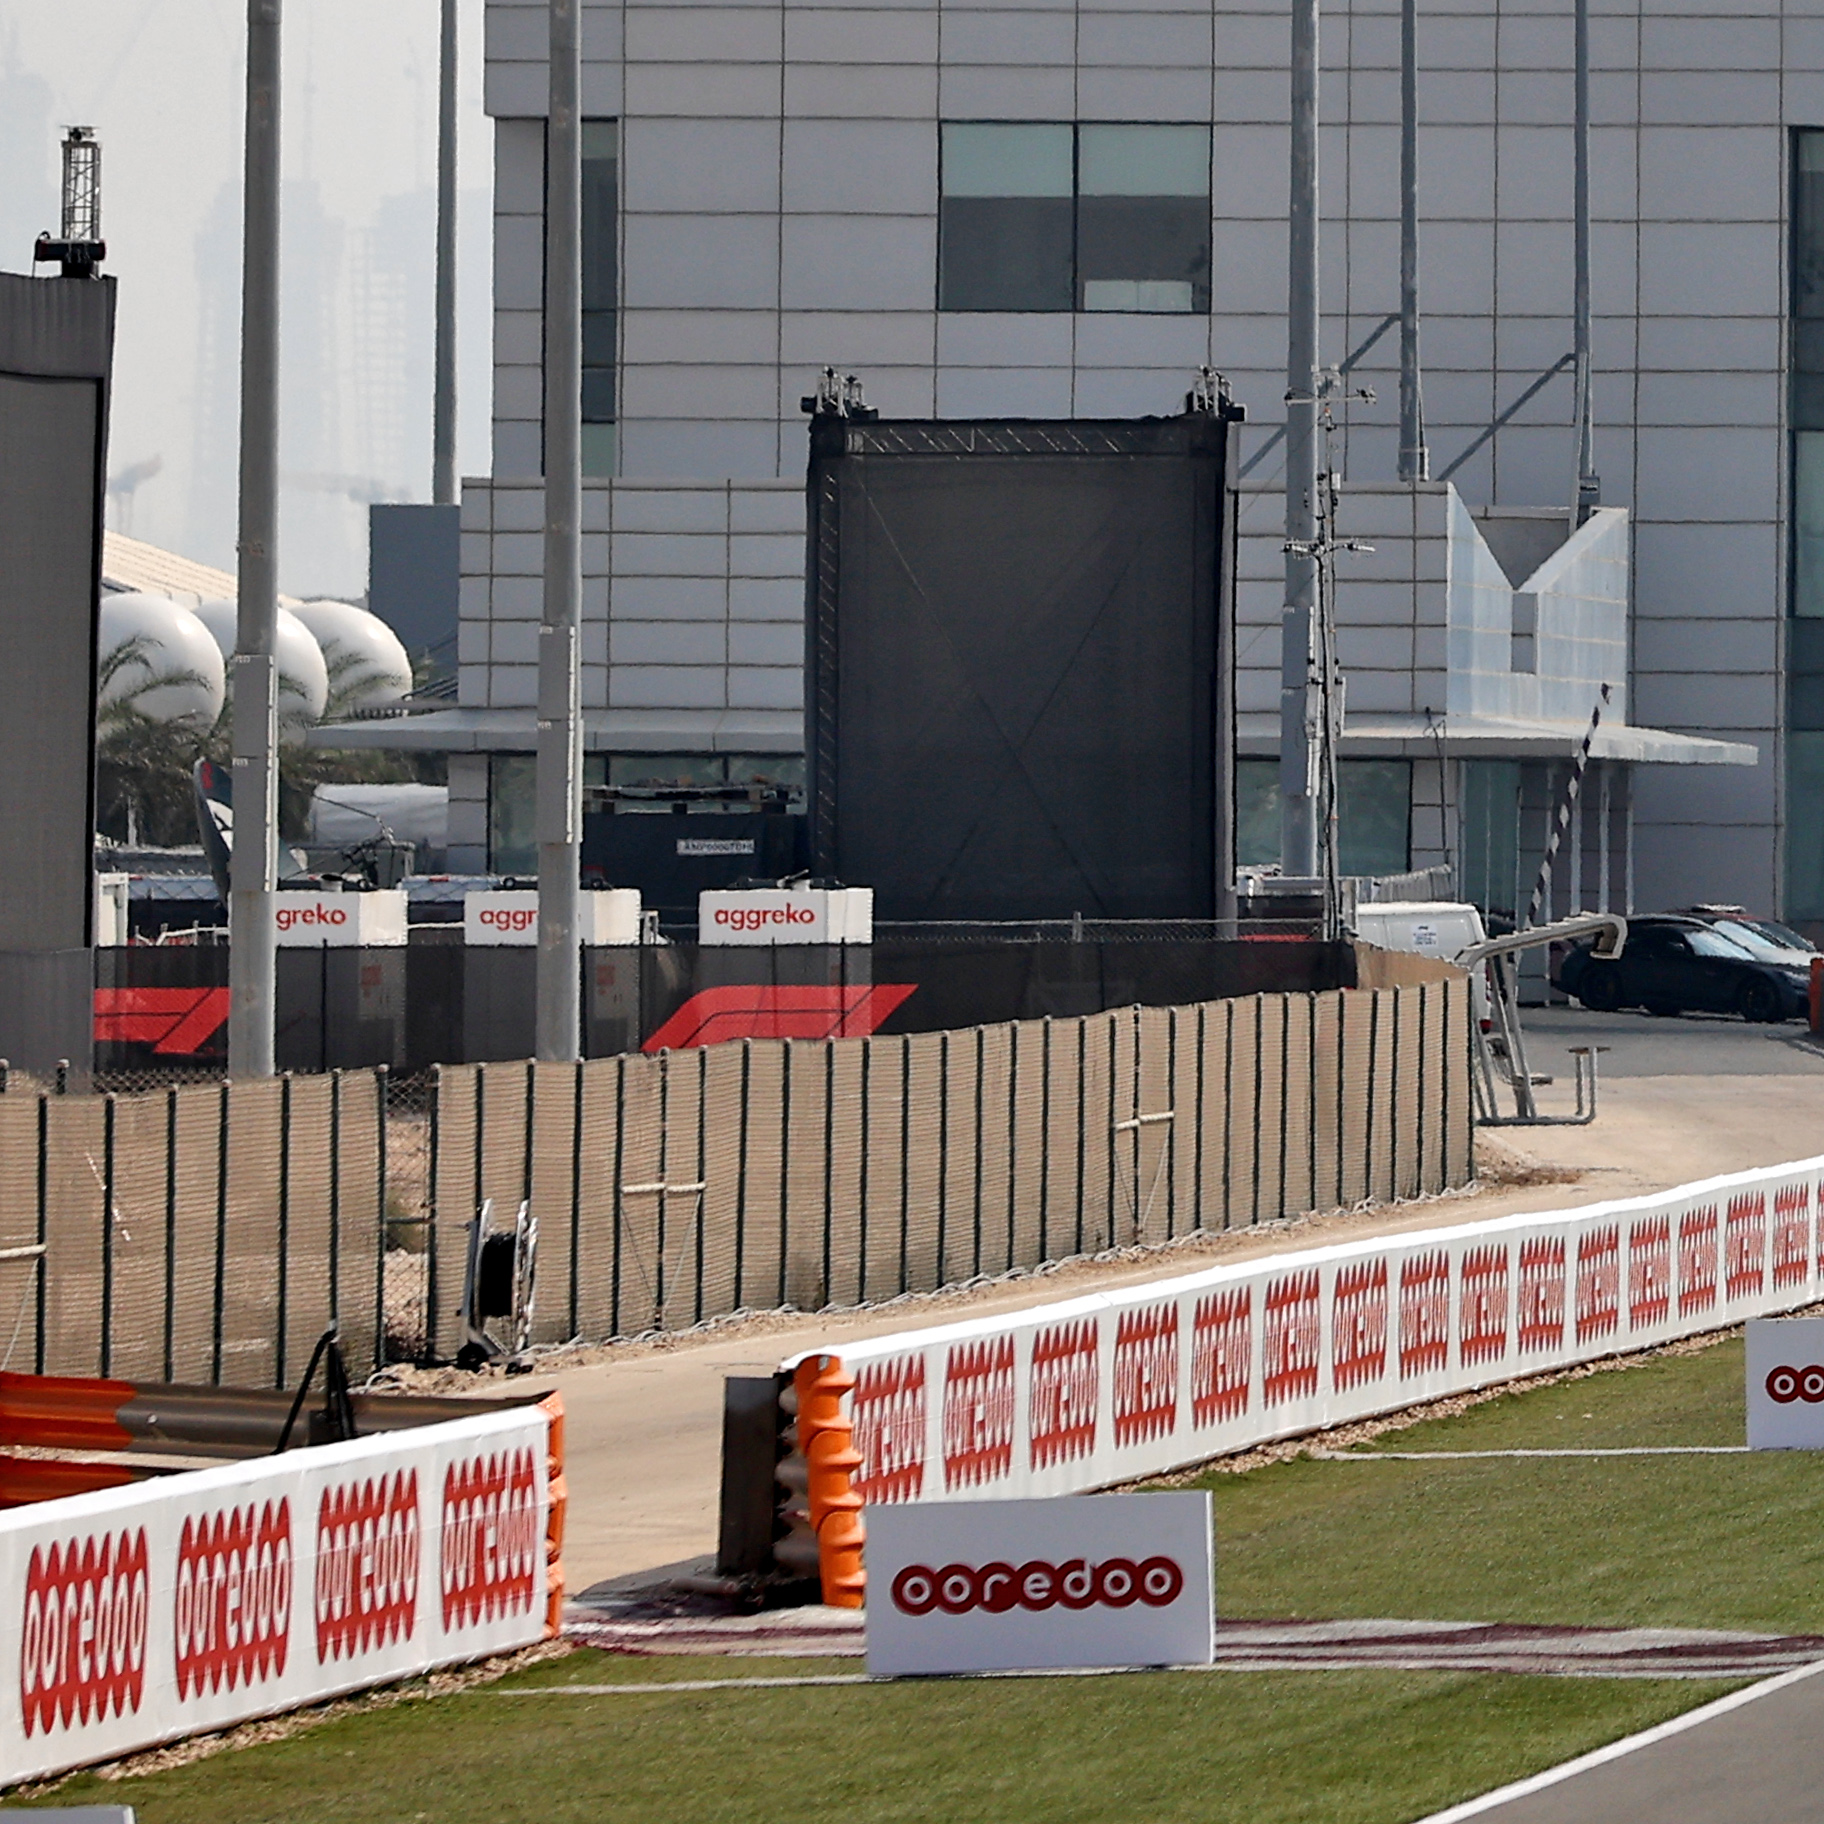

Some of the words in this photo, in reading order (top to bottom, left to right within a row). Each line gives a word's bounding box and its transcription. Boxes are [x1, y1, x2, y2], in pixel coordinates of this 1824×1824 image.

[275, 902, 347, 931] greko
[478, 908, 538, 931] aggr
[714, 902, 815, 931] aggreko
[315, 1484, 420, 1648] ooredoo
[894, 1556, 1180, 1611] ooredoo
[175, 1513, 293, 1684] ooredoo
[21, 1541, 148, 1714] ooredoo
